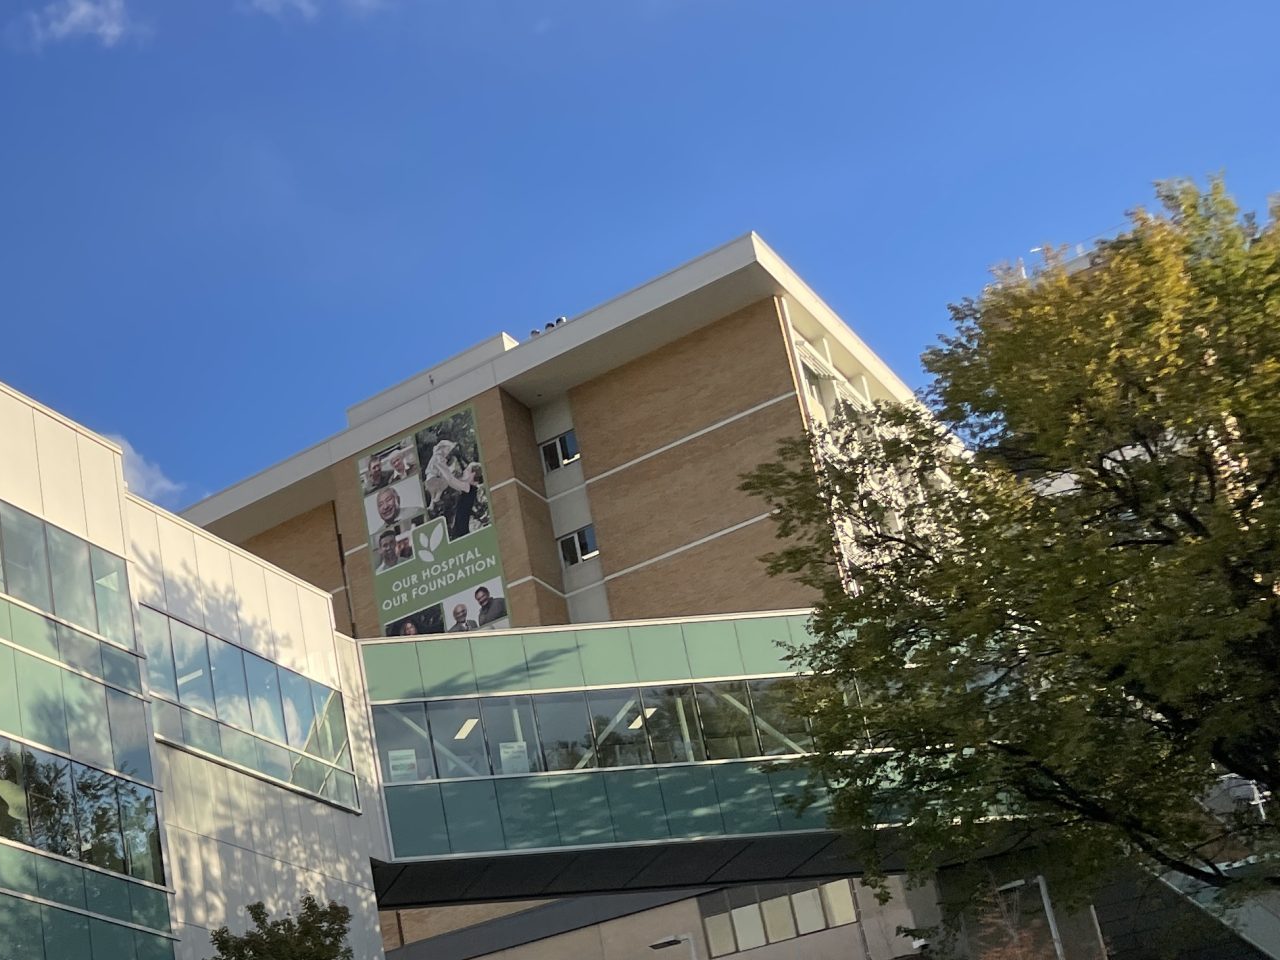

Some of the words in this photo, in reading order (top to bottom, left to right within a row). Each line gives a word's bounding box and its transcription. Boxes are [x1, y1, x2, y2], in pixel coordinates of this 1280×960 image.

[382, 591, 408, 610] OUR
[411, 555, 496, 600] FOUNDATION
[391, 573, 419, 592] OUR
[422, 547, 482, 580] HOSPITAL
